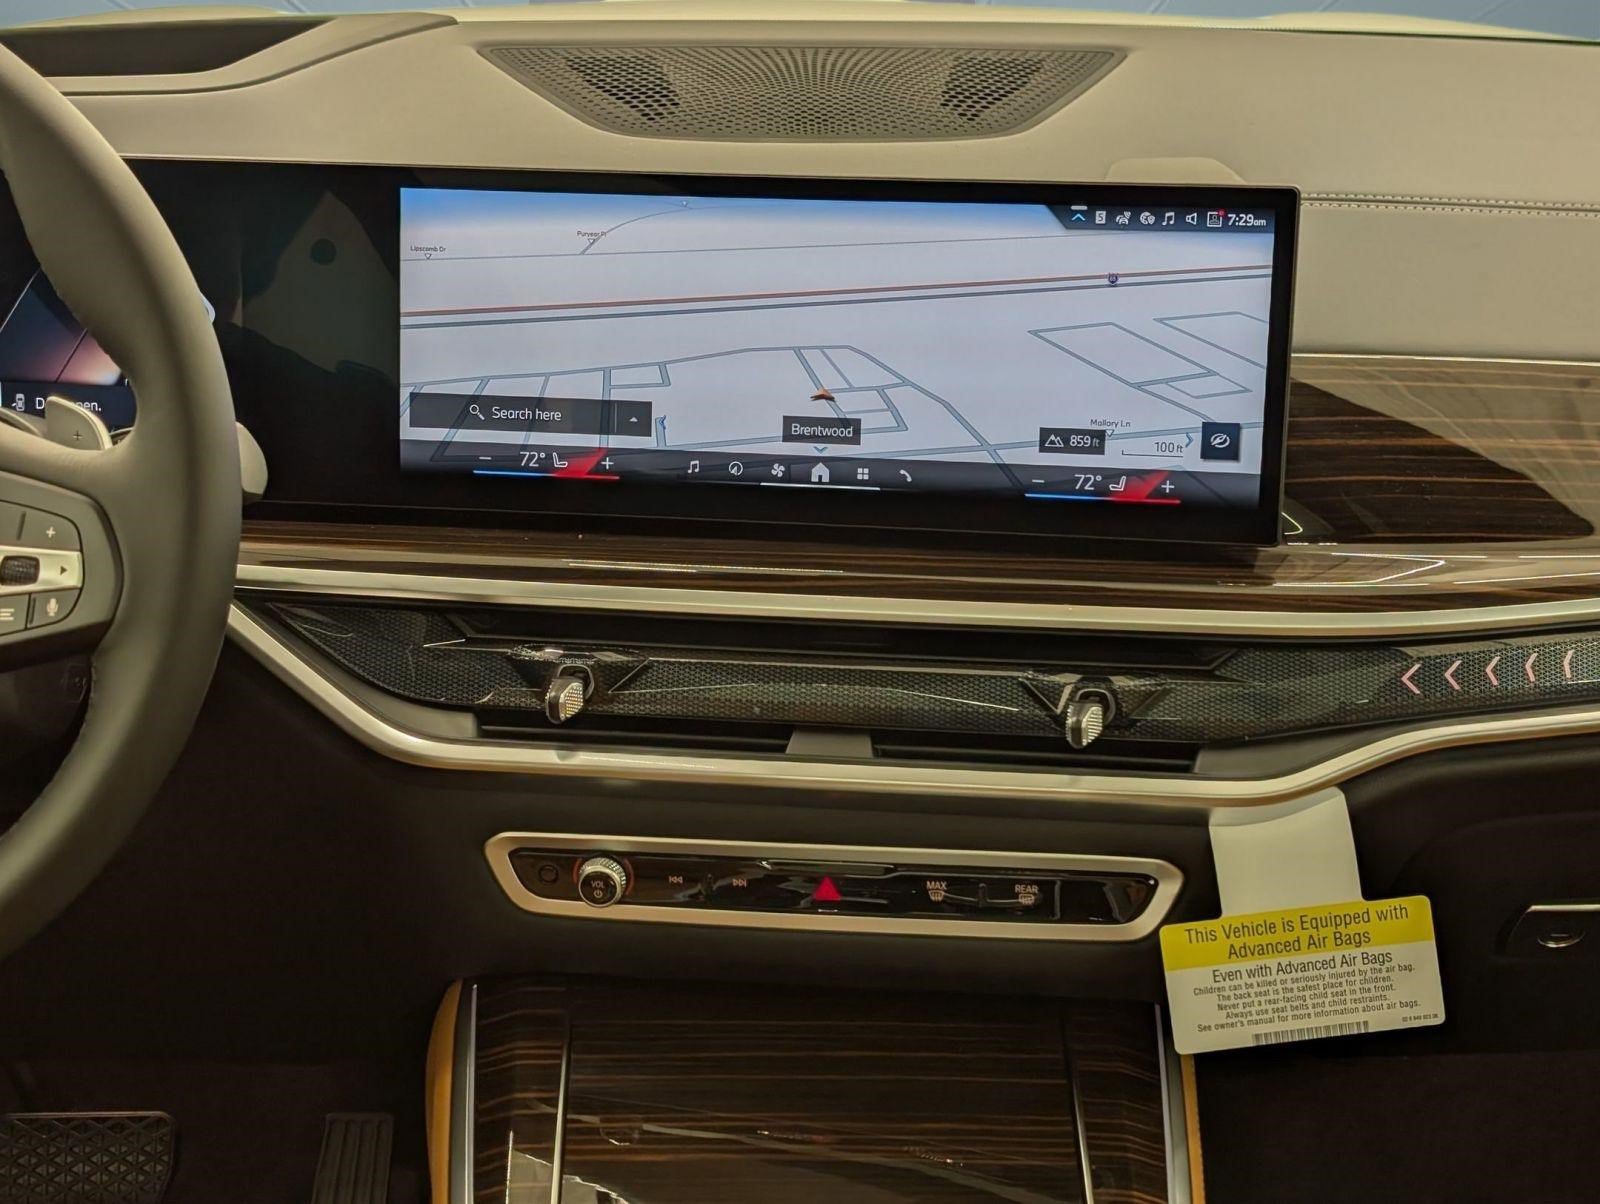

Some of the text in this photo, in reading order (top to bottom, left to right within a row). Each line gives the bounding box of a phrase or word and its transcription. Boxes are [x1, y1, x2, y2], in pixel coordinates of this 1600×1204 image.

[1228, 213, 1266, 227] 7:29am
[492, 406, 562, 421] Search here
[791, 423, 853, 437] Brentwood
[1090, 418, 1131, 428] Mallory Ln
[1069, 435, 1101, 448] 859 ft
[1154, 441, 1184, 454] 100 ft
[519, 451, 546, 468] 72°
[1074, 474, 1103, 491] 72°
[591, 880, 604, 888] VOL
[926, 881, 948, 890] MAX
[1014, 884, 1039, 894] REAR
[1184, 904, 1408, 944] This Vehicle is Equipped with
[1228, 930, 1371, 960] Advanced Air Bags
[1212, 952, 1393, 984] Even with Advanced Air Bags
[1193, 985, 1226, 996] Children
[1228, 984, 1242, 992] can
[1244, 982, 1254, 990] be
[1256, 978, 1278, 988] killed
[1290, 972, 1326, 984] seriously
[1328, 970, 1356, 981] injured
[1358, 968, 1368, 978] by
[1370, 966, 1383, 975] the
[1385, 965, 1396, 973] air
[1398, 964, 1416, 974] bag.
[1217, 976, 1394, 1002] The back seat is the safest place for children.
[1217, 1002, 1240, 1012] Never
[1242, 1001, 1255, 1010] put
[1264, 994, 1307, 1006] rear-facing
[1309, 992, 1328, 1000] child
[1330, 989, 1347, 998] seat
[1350, 987, 1357, 996] in
[1359, 986, 1372, 994] the
[1374, 984, 1396, 993] front.
[1196, 999, 1421, 1032] See owner's manual for more information about air bags.
[1226, 994, 1390, 1020] Always use seat belts and child restraints.
